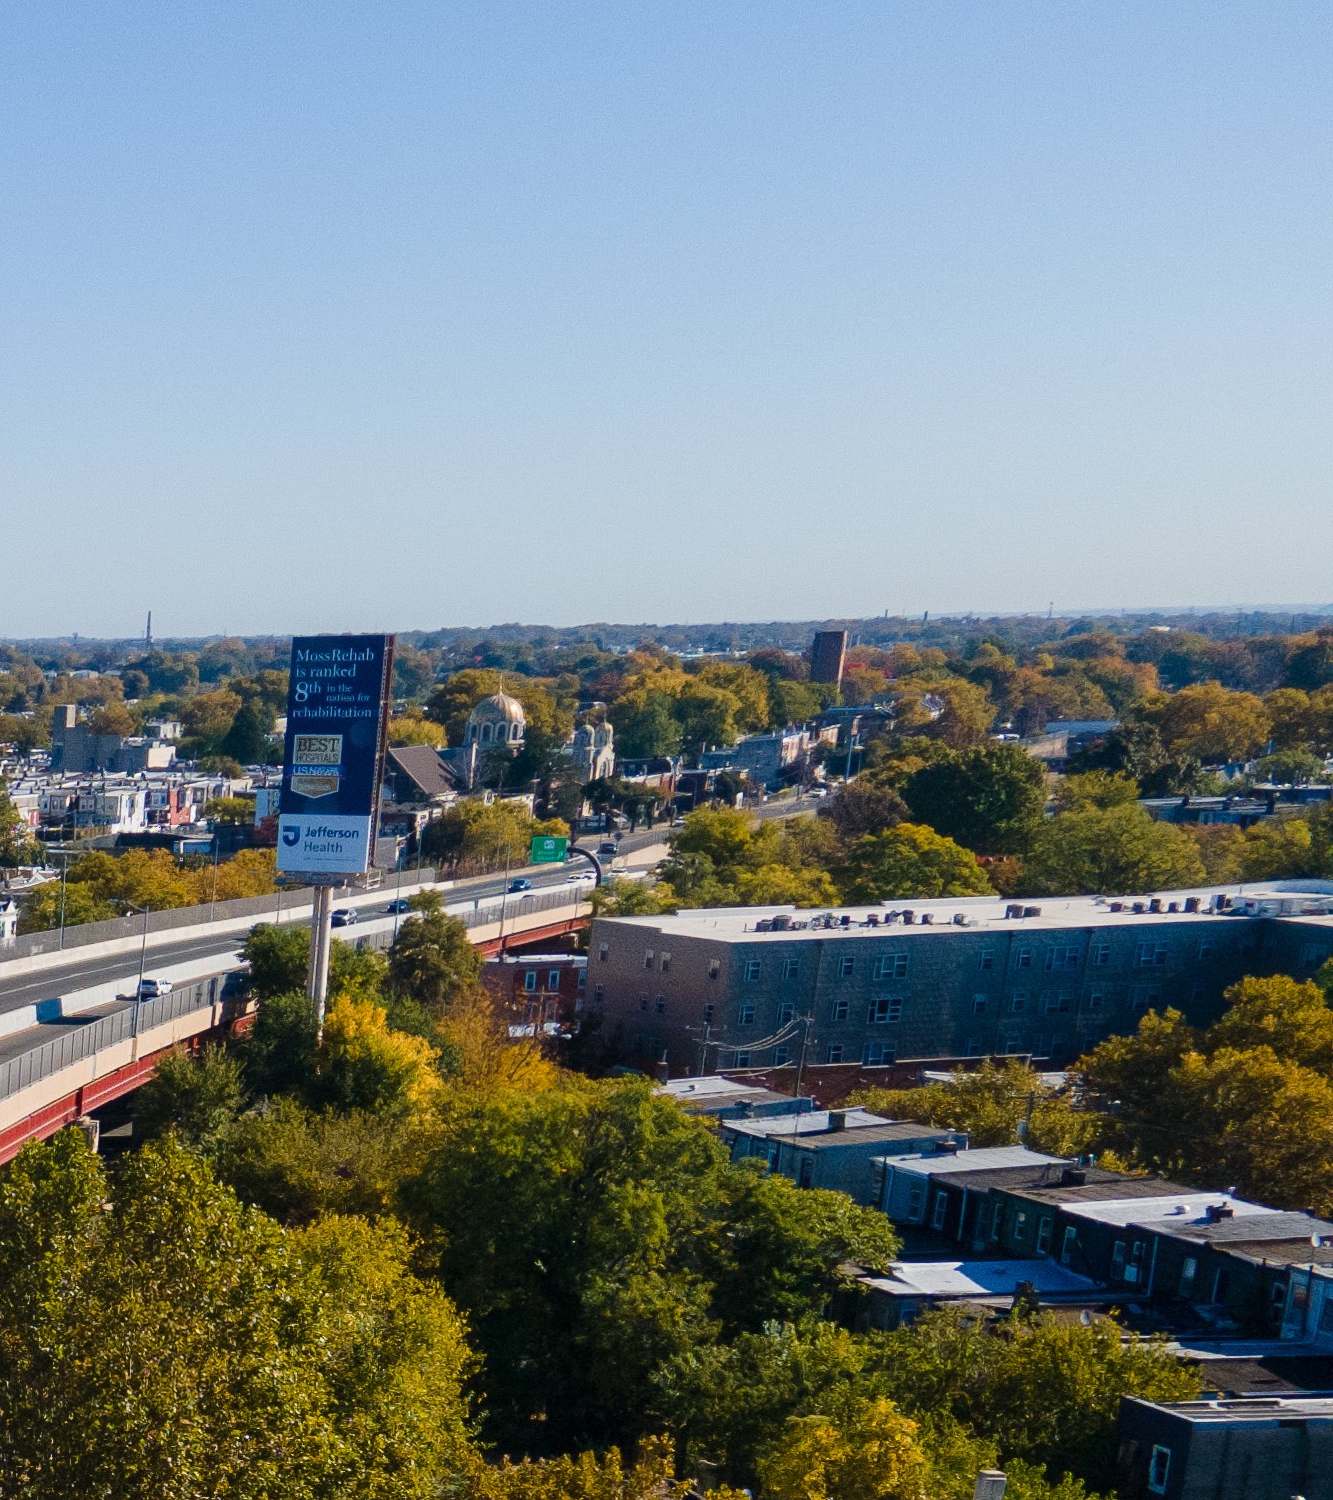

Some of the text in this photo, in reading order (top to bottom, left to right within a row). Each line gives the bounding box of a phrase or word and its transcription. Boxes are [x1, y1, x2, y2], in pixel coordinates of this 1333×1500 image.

[296, 647, 375, 662] MossRehab
[296, 663, 356, 677] is ranked
[295, 681, 353, 702] 8th in the
[357, 692, 371, 702] for
[292, 705, 372, 718] rehabilitation
[298, 737, 340, 752] BEST
[296, 752, 339, 763] HOSPITALS
[304, 825, 359, 839] Jefferson
[303, 841, 343, 853] Health
